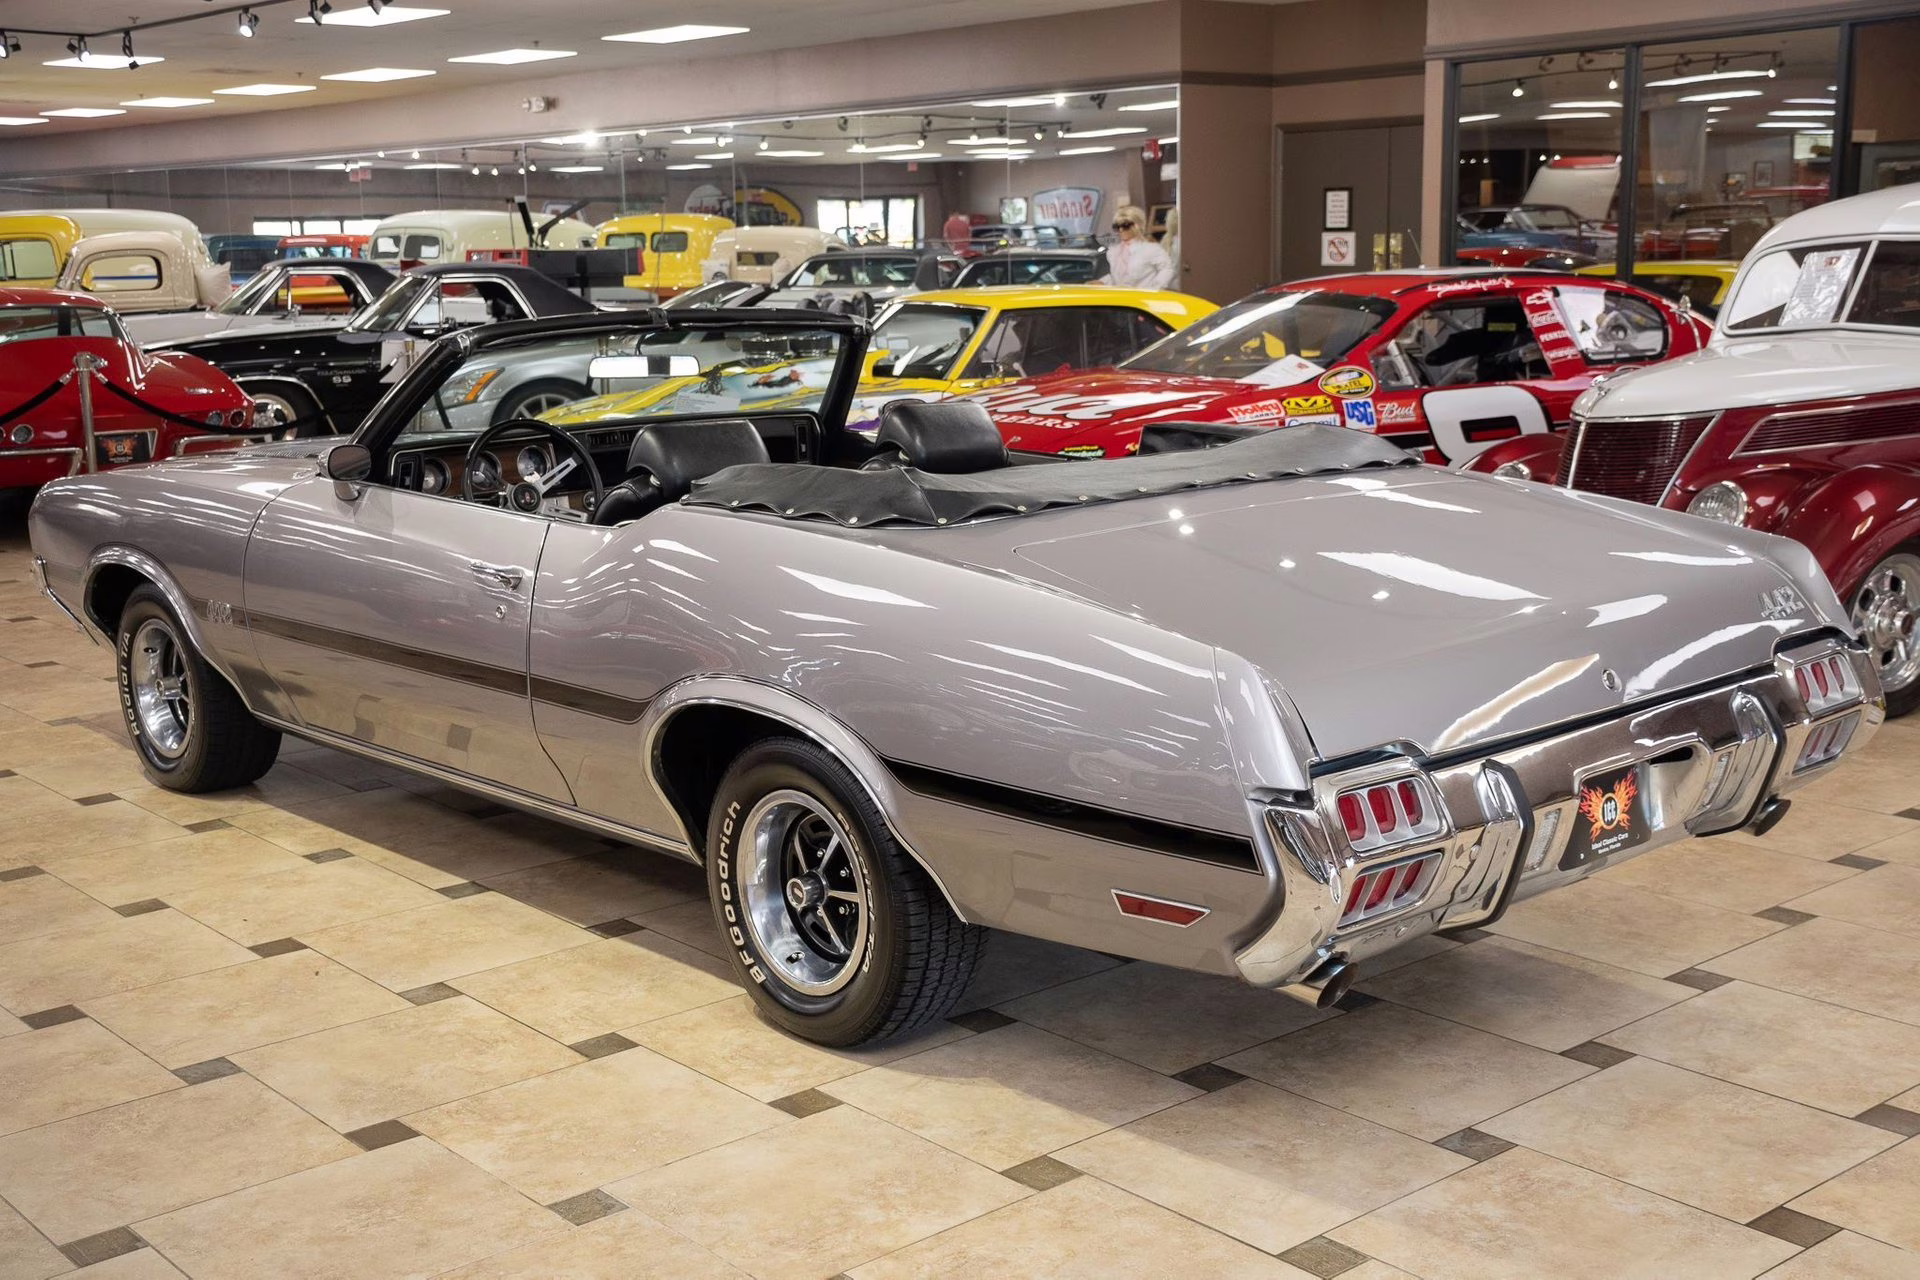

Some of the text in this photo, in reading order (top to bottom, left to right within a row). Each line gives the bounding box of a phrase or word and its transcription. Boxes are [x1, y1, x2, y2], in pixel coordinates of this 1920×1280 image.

[1230, 401, 1282, 419] Holley
[1346, 401, 1375, 426] USG
[1377, 400, 1416, 418] Bud
[120, 663, 141, 737] Radial
[717, 800, 767, 985] BFGoodrich
